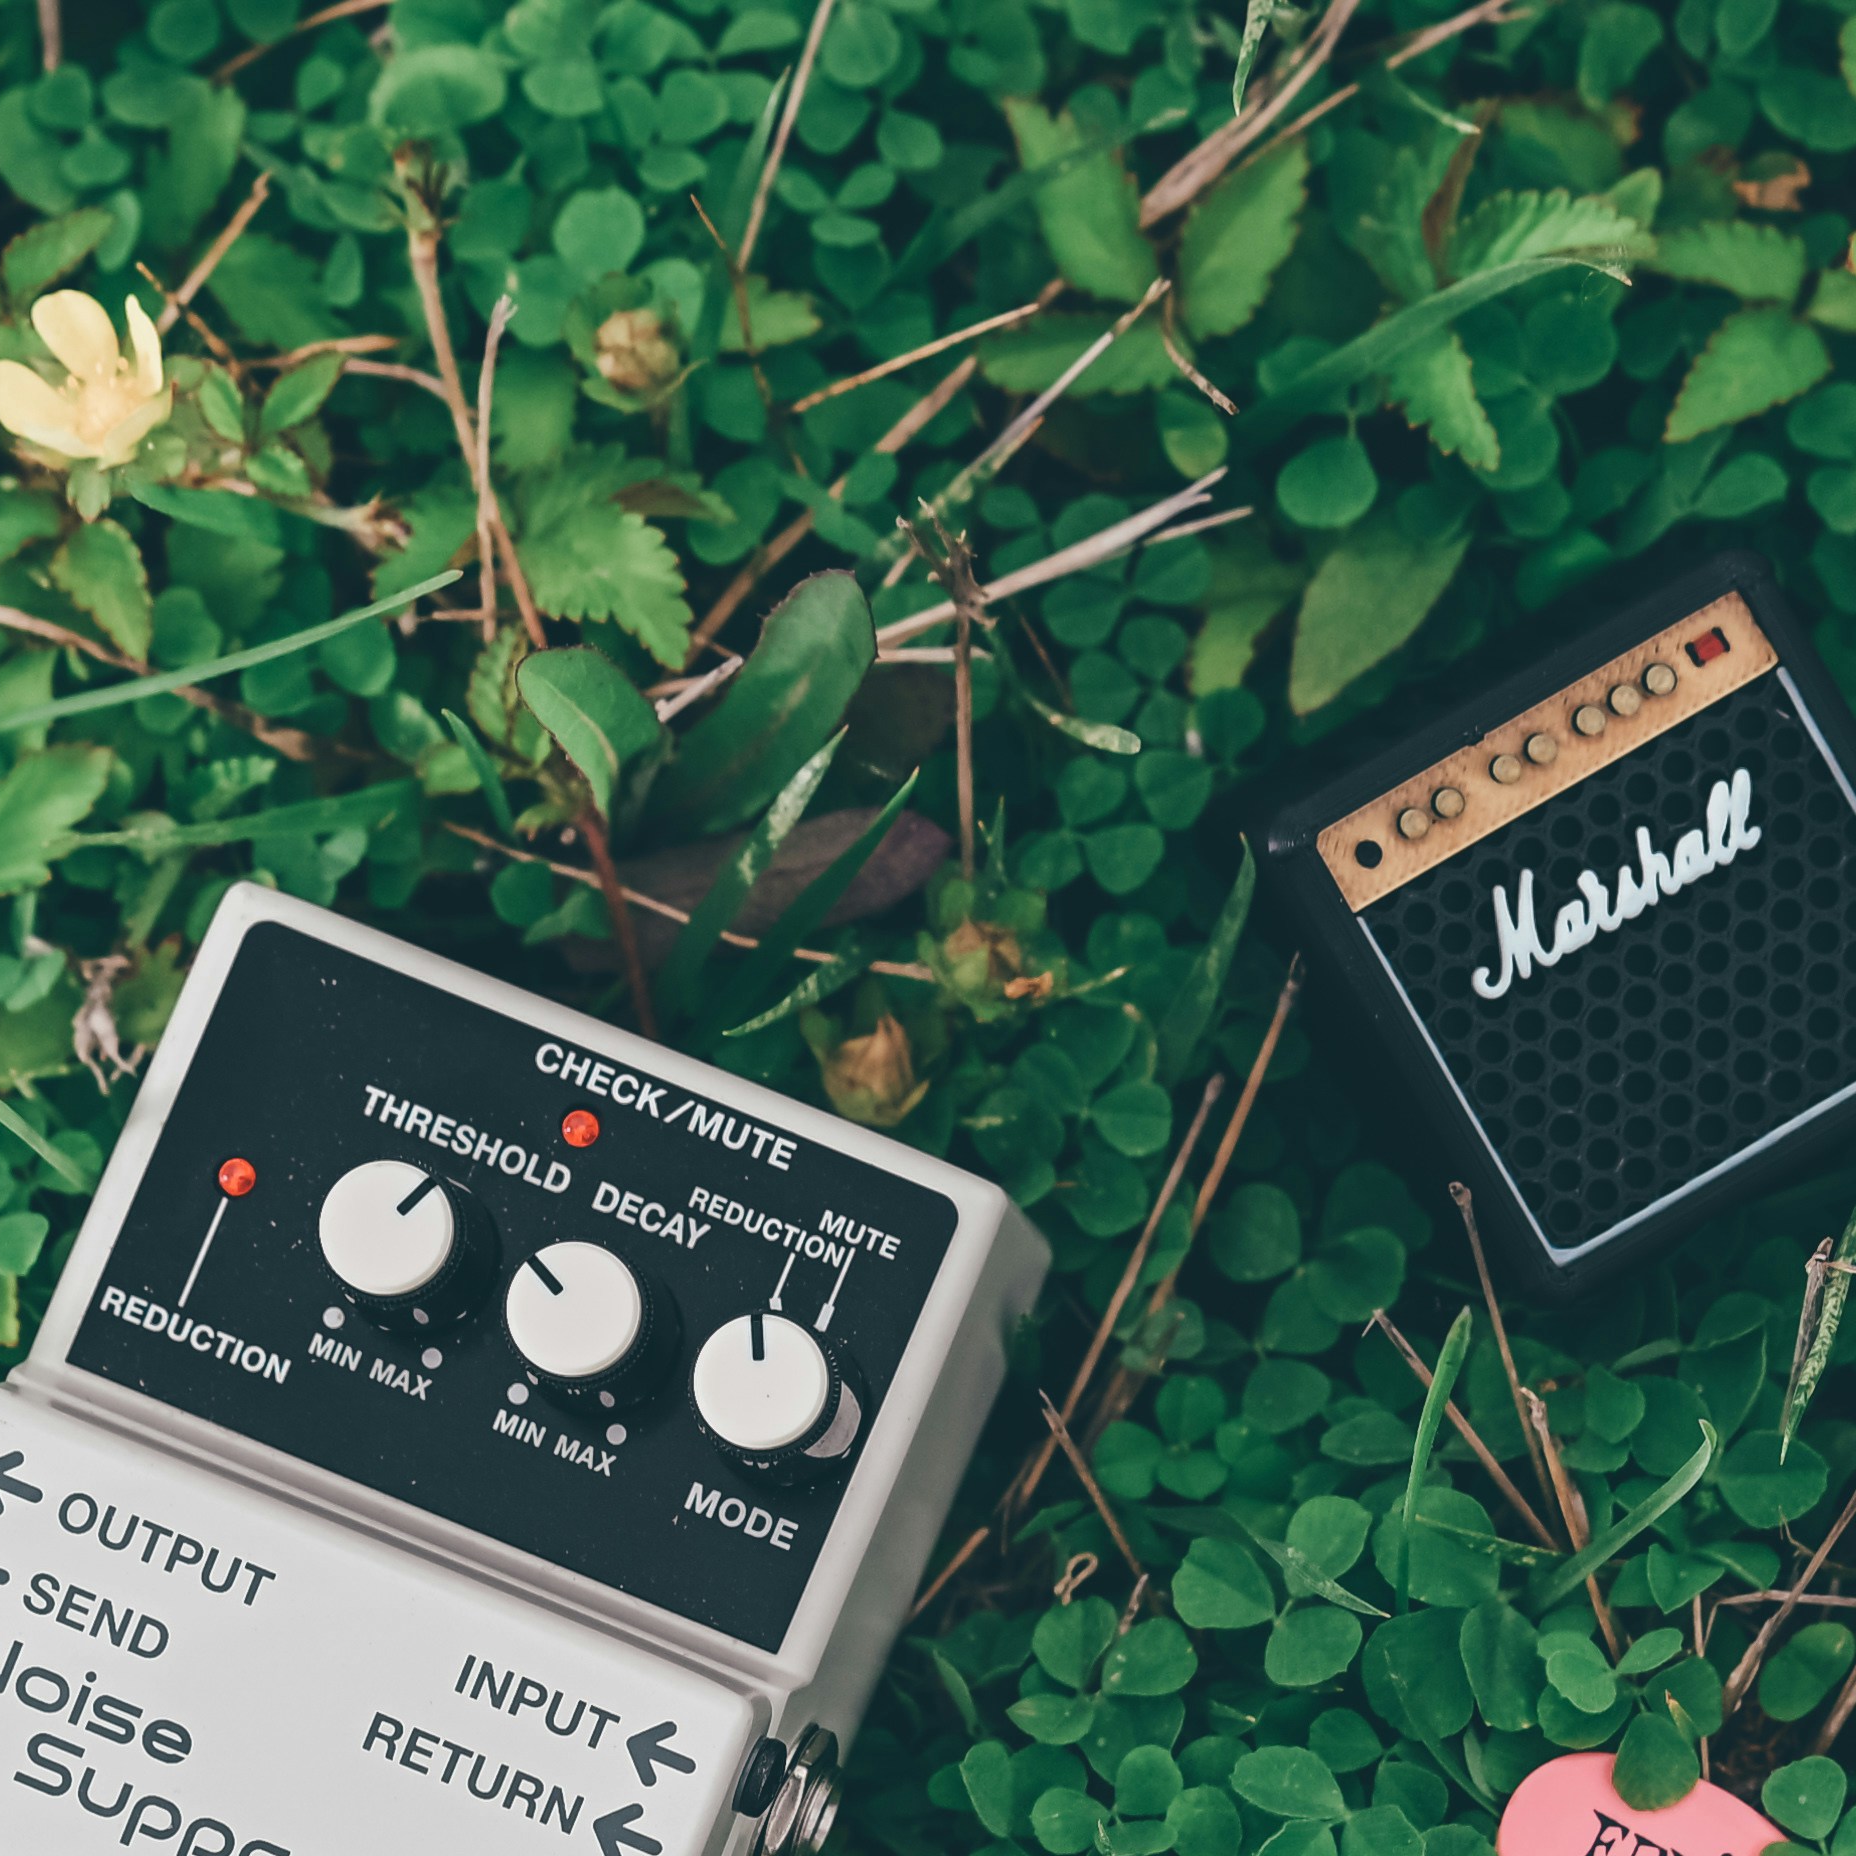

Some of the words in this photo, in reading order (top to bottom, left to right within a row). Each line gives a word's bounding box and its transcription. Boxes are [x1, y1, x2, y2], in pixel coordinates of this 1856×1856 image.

[1473, 769, 1761, 998] Marshall
[365, 1086, 570, 1192] THRESHOLD
[536, 1044, 797, 1170] CHECK/MUTE
[592, 1182, 710, 1248] DECAY
[689, 1187, 845, 1267] REDUCTION
[819, 1210, 900, 1259] MUTE
[101, 1286, 290, 1383] REDUCTION
[309, 1333, 362, 1371] MIN
[370, 1359, 432, 1400] MAX
[493, 1409, 546, 1447] MIN
[554, 1435, 616, 1476] MAX
[59, 1493, 276, 1605] OUTPUT
[685, 1482, 798, 1550] MODE
[24, 1574, 168, 1658] SEND
[455, 1655, 620, 1748] INPUT
[363, 1712, 584, 1834] RETURN
